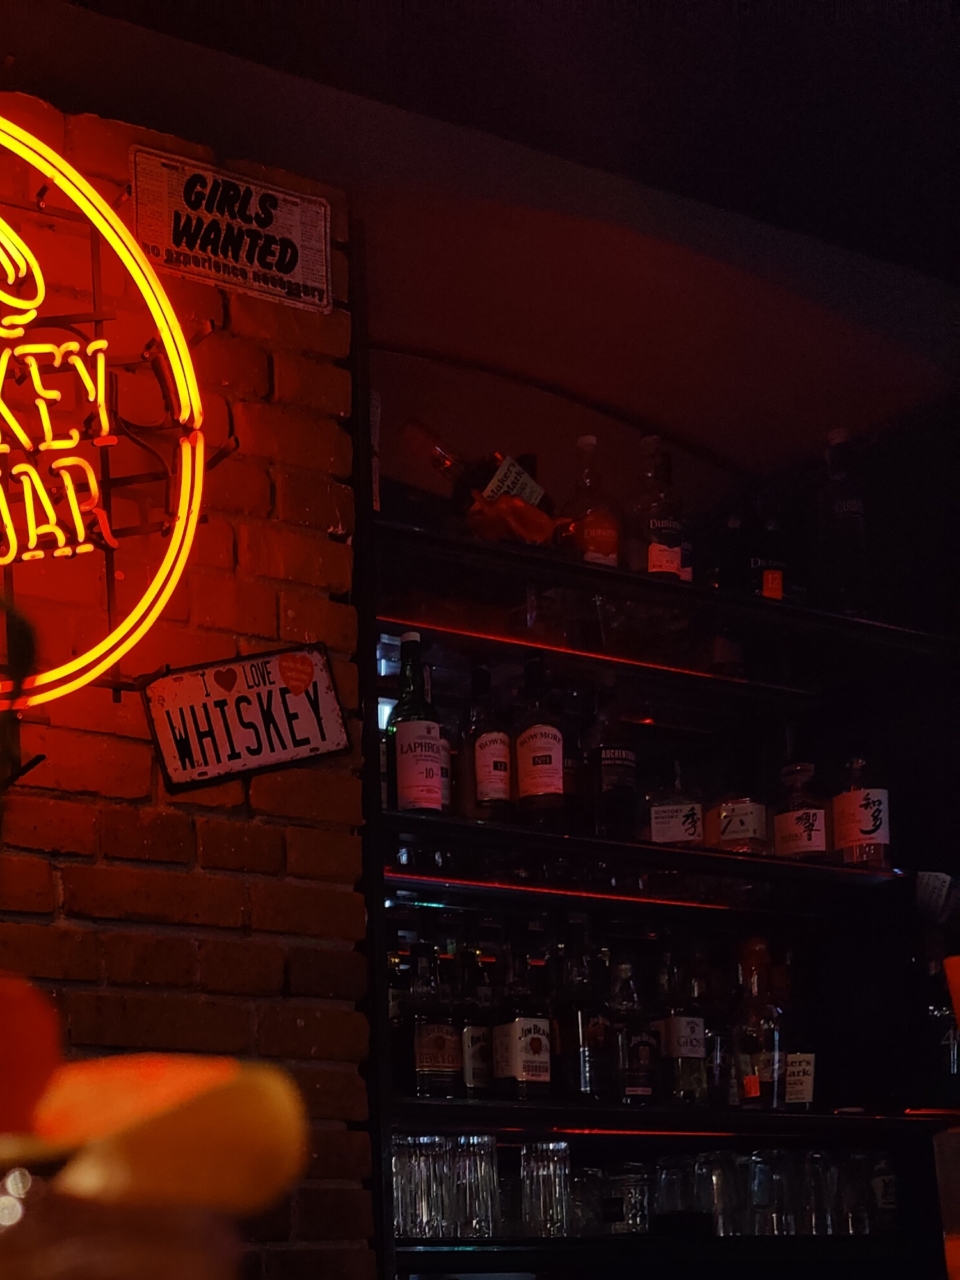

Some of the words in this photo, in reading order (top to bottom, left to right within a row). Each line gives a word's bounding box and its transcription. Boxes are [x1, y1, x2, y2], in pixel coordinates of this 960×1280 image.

[183, 173, 278, 229] GIRLS
[172, 210, 299, 275] WANTED
[164, 248, 248, 279] experience
[767, 573, 780, 589] 12
[199, 670, 211, 697] I
[242, 660, 276, 690] LOVE
[165, 680, 327, 771] WHISKEY
[424, 767, 434, 779] 10
[787, 1068, 811, 1077] ark
